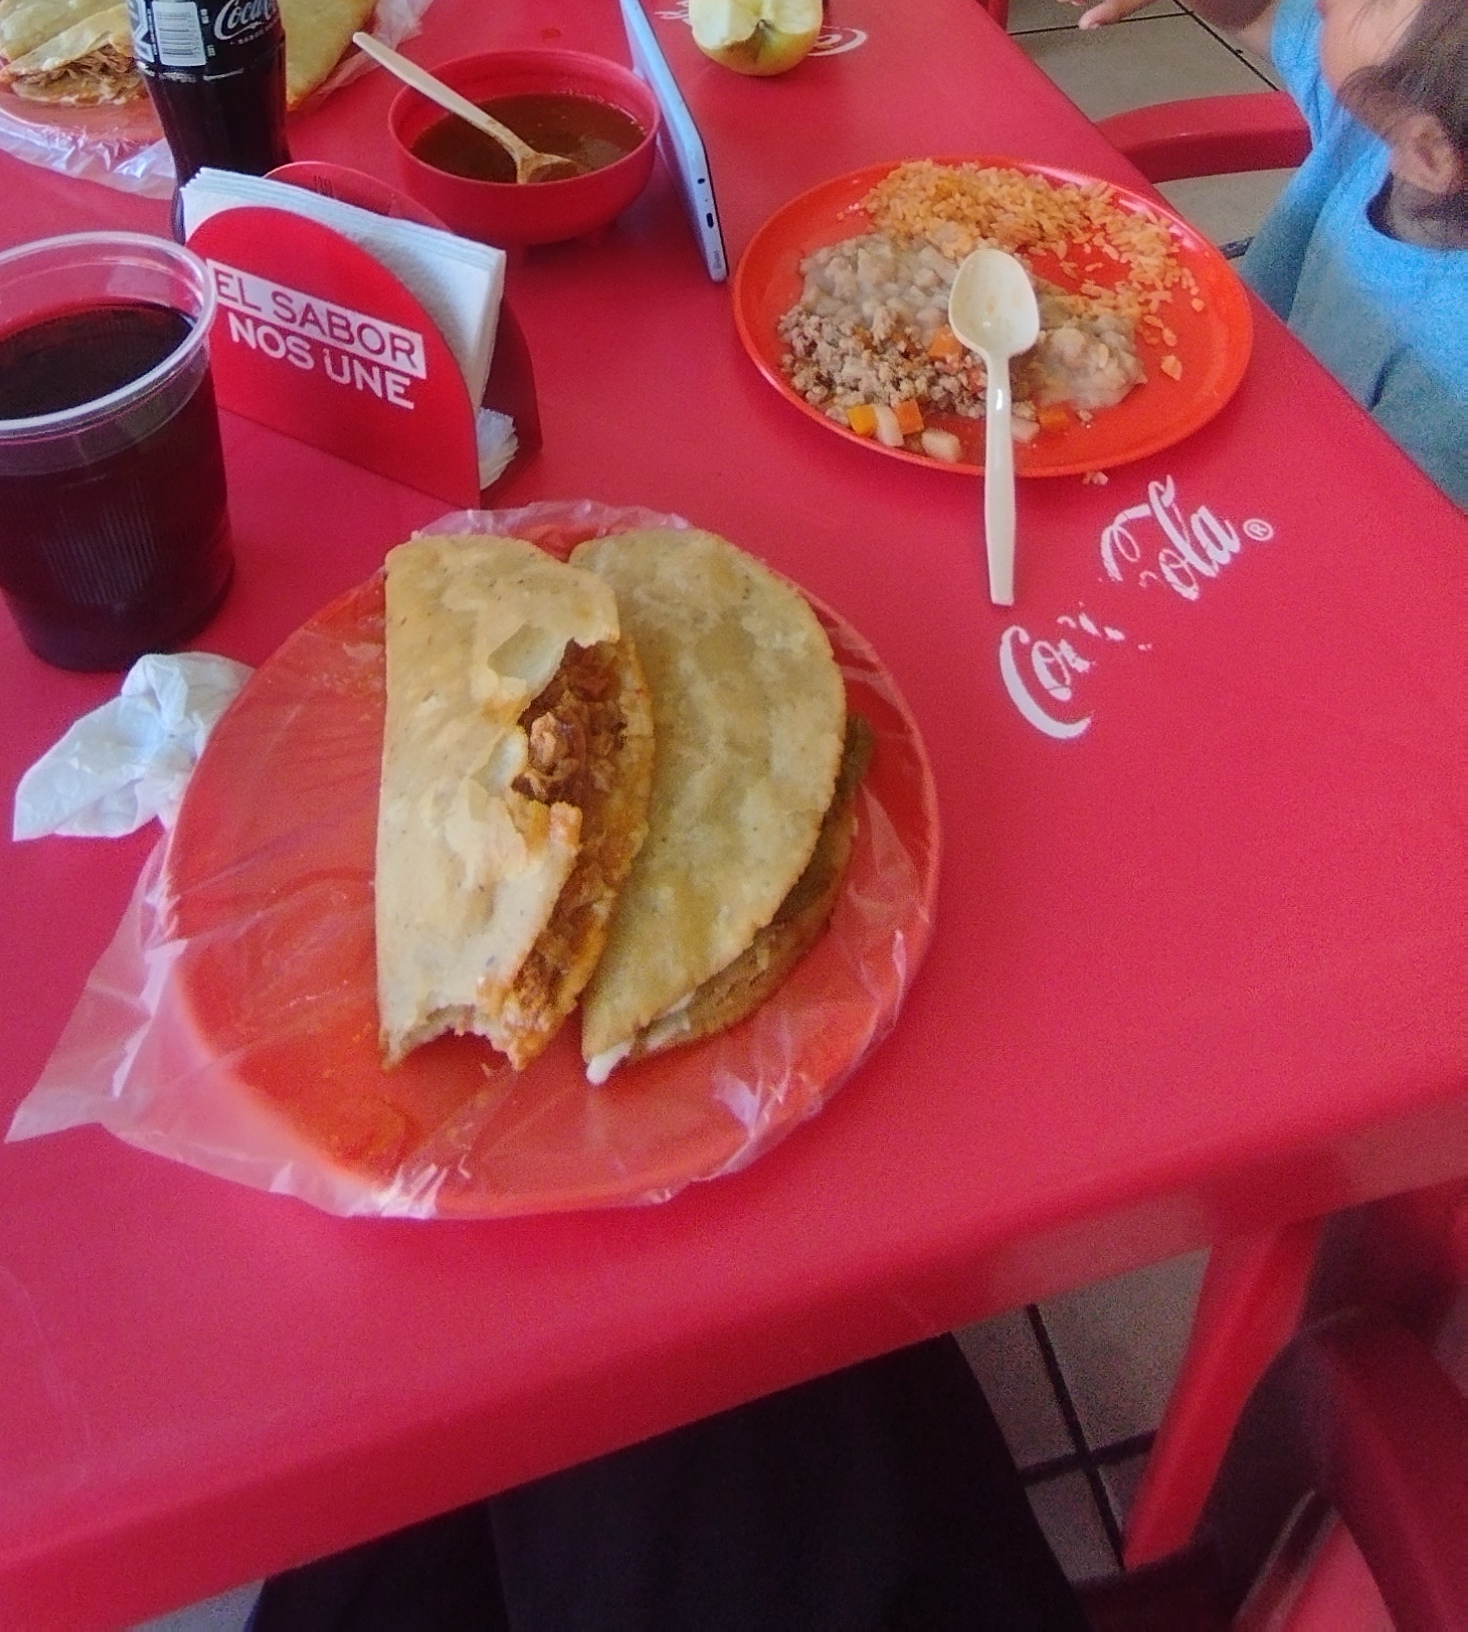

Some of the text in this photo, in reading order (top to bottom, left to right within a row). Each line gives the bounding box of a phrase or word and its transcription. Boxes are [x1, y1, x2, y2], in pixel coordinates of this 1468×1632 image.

[214, 269, 418, 369] EL SABOR
[227, 312, 415, 411] NOS UNE
